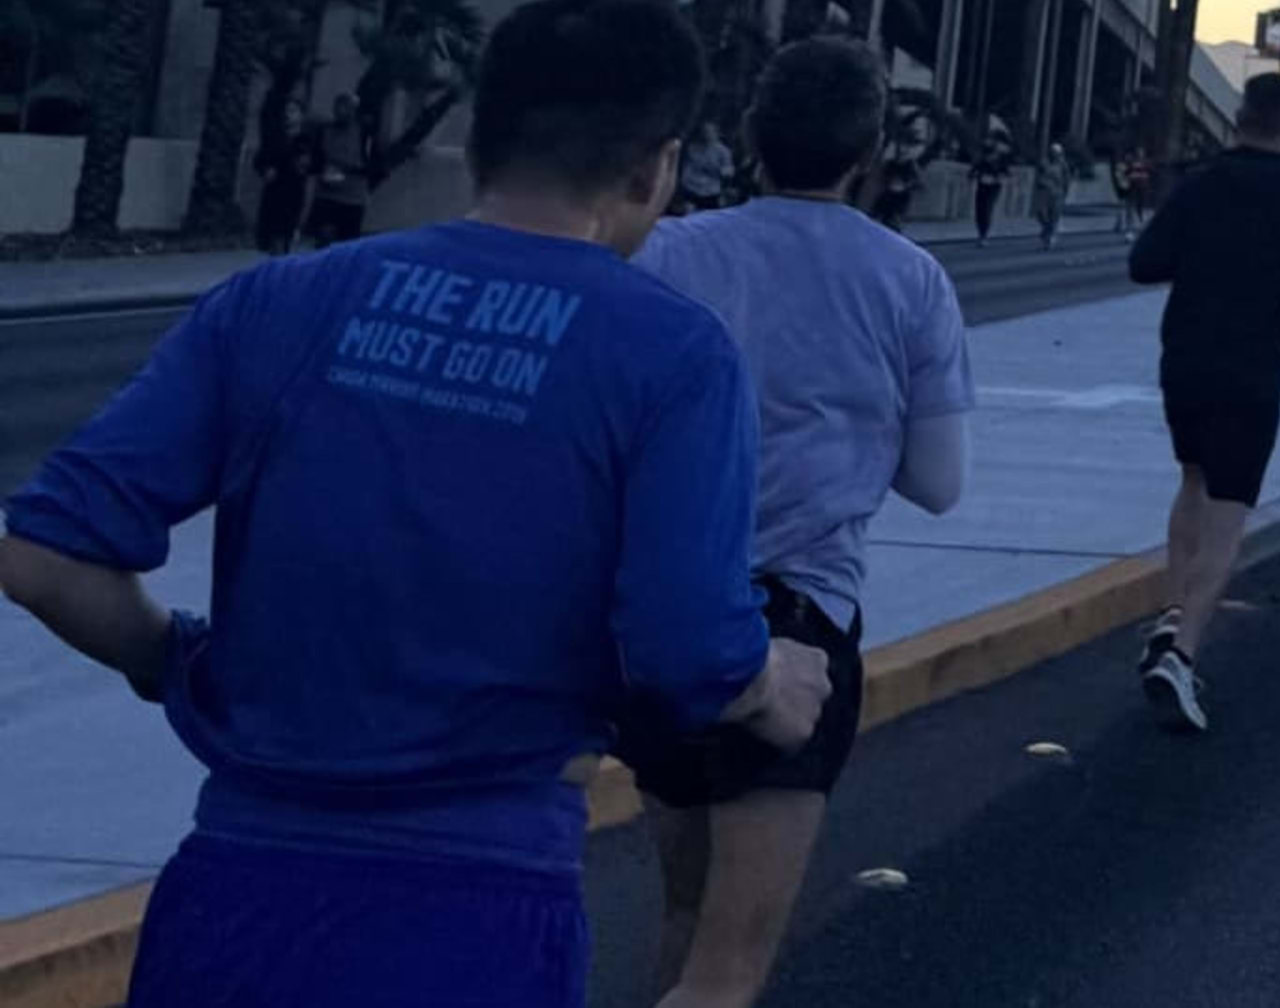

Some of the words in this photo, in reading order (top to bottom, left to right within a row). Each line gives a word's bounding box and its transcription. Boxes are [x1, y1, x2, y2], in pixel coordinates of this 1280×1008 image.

[369, 259, 475, 325] THE
[465, 279, 582, 346] RUN
[337, 316, 446, 372] MUST
[442, 340, 494, 383] GO
[492, 348, 549, 396] ON
